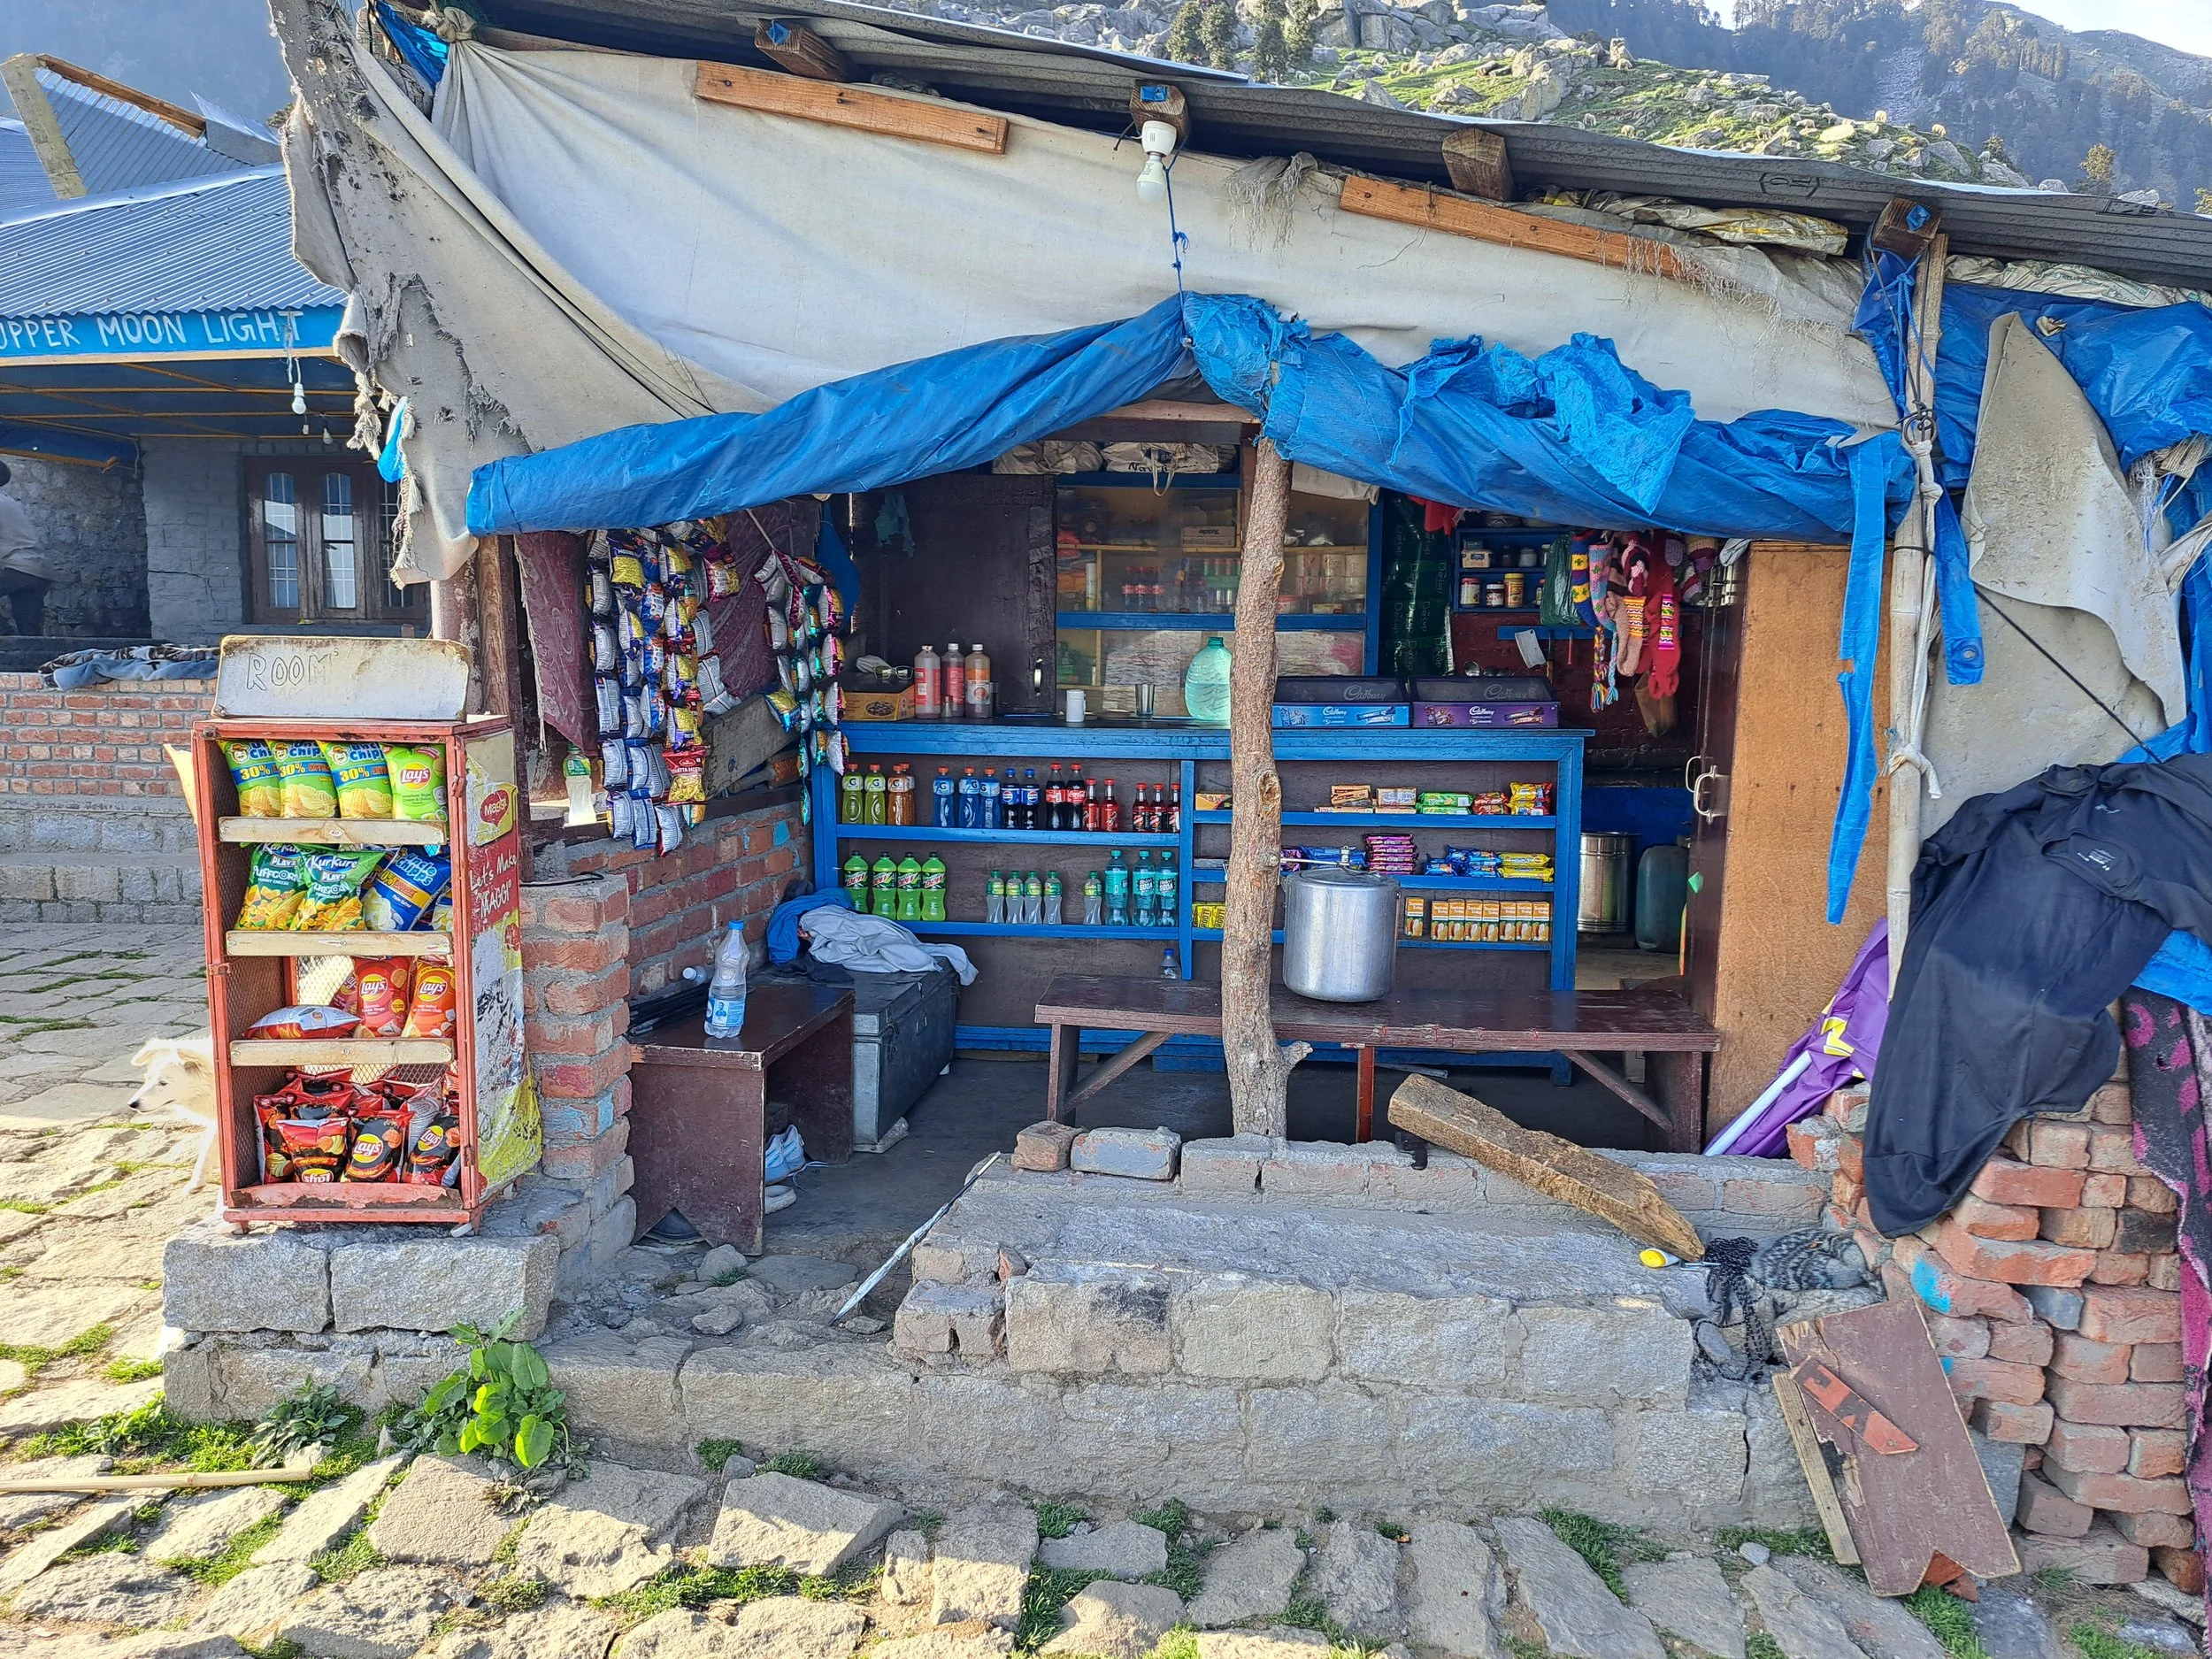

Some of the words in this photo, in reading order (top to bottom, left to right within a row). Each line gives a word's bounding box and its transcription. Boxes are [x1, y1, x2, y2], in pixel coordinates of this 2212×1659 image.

[96, 313, 188, 348] MOON
[201, 310, 303, 343] LIGHT
[1343, 685, 1386, 701] Cadbury
[1322, 706, 1348, 716] Cadbury
[1469, 706, 1495, 715] Cadbury
[240, 764, 271, 780] 30%
[280, 763, 305, 778] 30%
[339, 766, 370, 782] 30%
[400, 767, 430, 784] Lay's
[940, 781, 947, 790] G
[497, 852, 518, 876] Make
[361, 979, 387, 995] Lay's
[419, 981, 445, 996] Lay's
